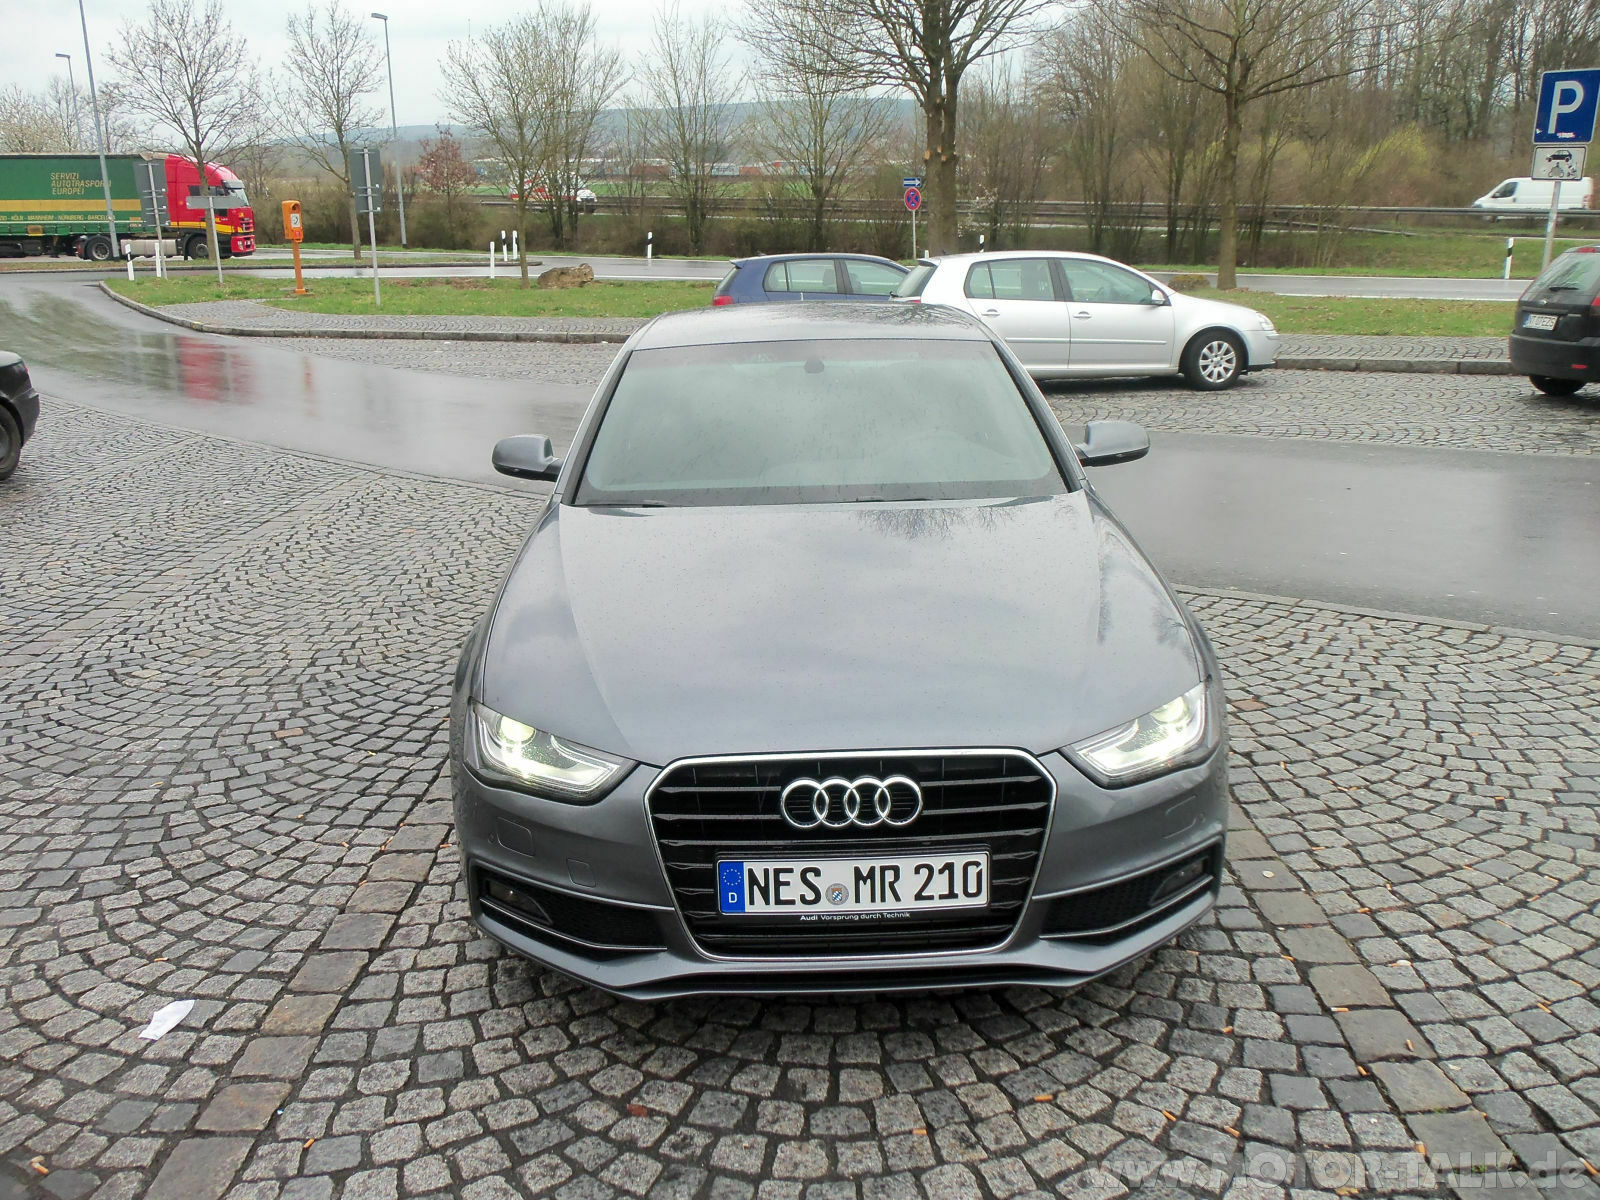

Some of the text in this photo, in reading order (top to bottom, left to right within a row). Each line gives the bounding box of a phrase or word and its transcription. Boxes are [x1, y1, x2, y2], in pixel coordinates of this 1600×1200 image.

[1547, 80, 1584, 135] P
[51, 179, 112, 188] AUTOTRASPORI
[52, 187, 85, 195] EUROPEI
[747, 860, 983, 906] NES MR 210
[728, 892, 738, 903] D
[820, 913, 859, 921] Vorsprung
[860, 912, 882, 920] durch
[882, 911, 911, 919] Technik
